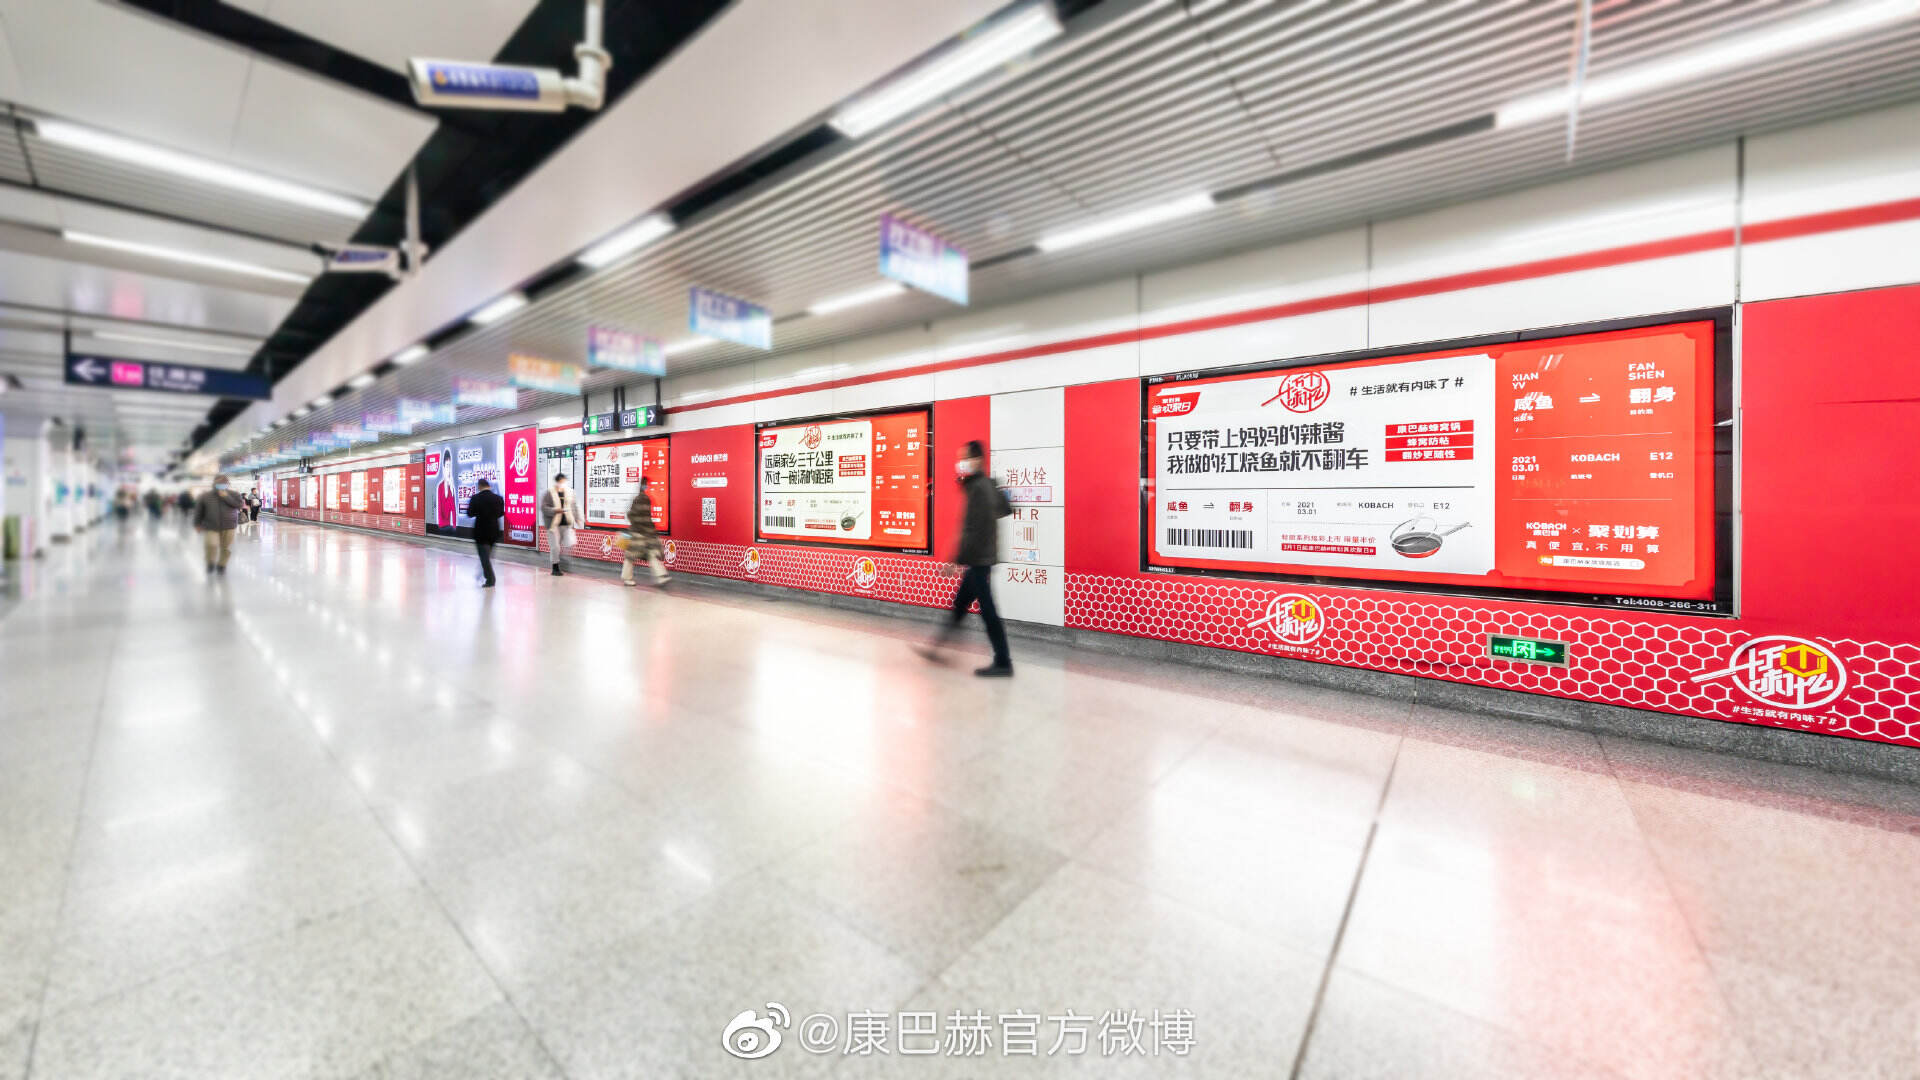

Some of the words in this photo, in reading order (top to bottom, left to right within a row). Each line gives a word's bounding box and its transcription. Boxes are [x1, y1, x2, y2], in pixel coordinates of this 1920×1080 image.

[1628, 362, 1655, 372] FAN
[1512, 372, 1539, 382] XIAN
[1628, 370, 1665, 380] SHEN
[1361, 378, 1450, 396] 生活就有内味了
[1512, 382, 1526, 390] YV
[1629, 386, 1676, 404] 翻身
[1513, 395, 1554, 411] 咸鱼
[1396, 422, 1461, 434] 康巴赫蜂窝锅
[1167, 421, 1345, 451] 只要带上妈妈的辣酱
[1407, 437, 1450, 447] 蜂窝防粘
[764, 450, 834, 469] 远离家乡三千公里
[1167, 448, 1369, 474] 我做的红烧鱼就不翻车
[1512, 456, 1537, 464] 2021
[1570, 453, 1621, 462] KOBACH
[1650, 452, 1673, 460] E12
[1512, 464, 1540, 472] 03.01
[764, 469, 834, 485] 不过一碗汤的距离
[1006, 466, 1047, 486] 消火栓
[1166, 501, 1189, 512] 咸鱼
[1229, 501, 1254, 513] 翻身
[1433, 502, 1450, 510] E12
[1588, 524, 1660, 539] 聚划算
[1007, 567, 1048, 585] 灭火器
[1615, 597, 1717, 611] Tel:4008-266-311
[1732, 705, 1838, 726] #生活就有内味了#
